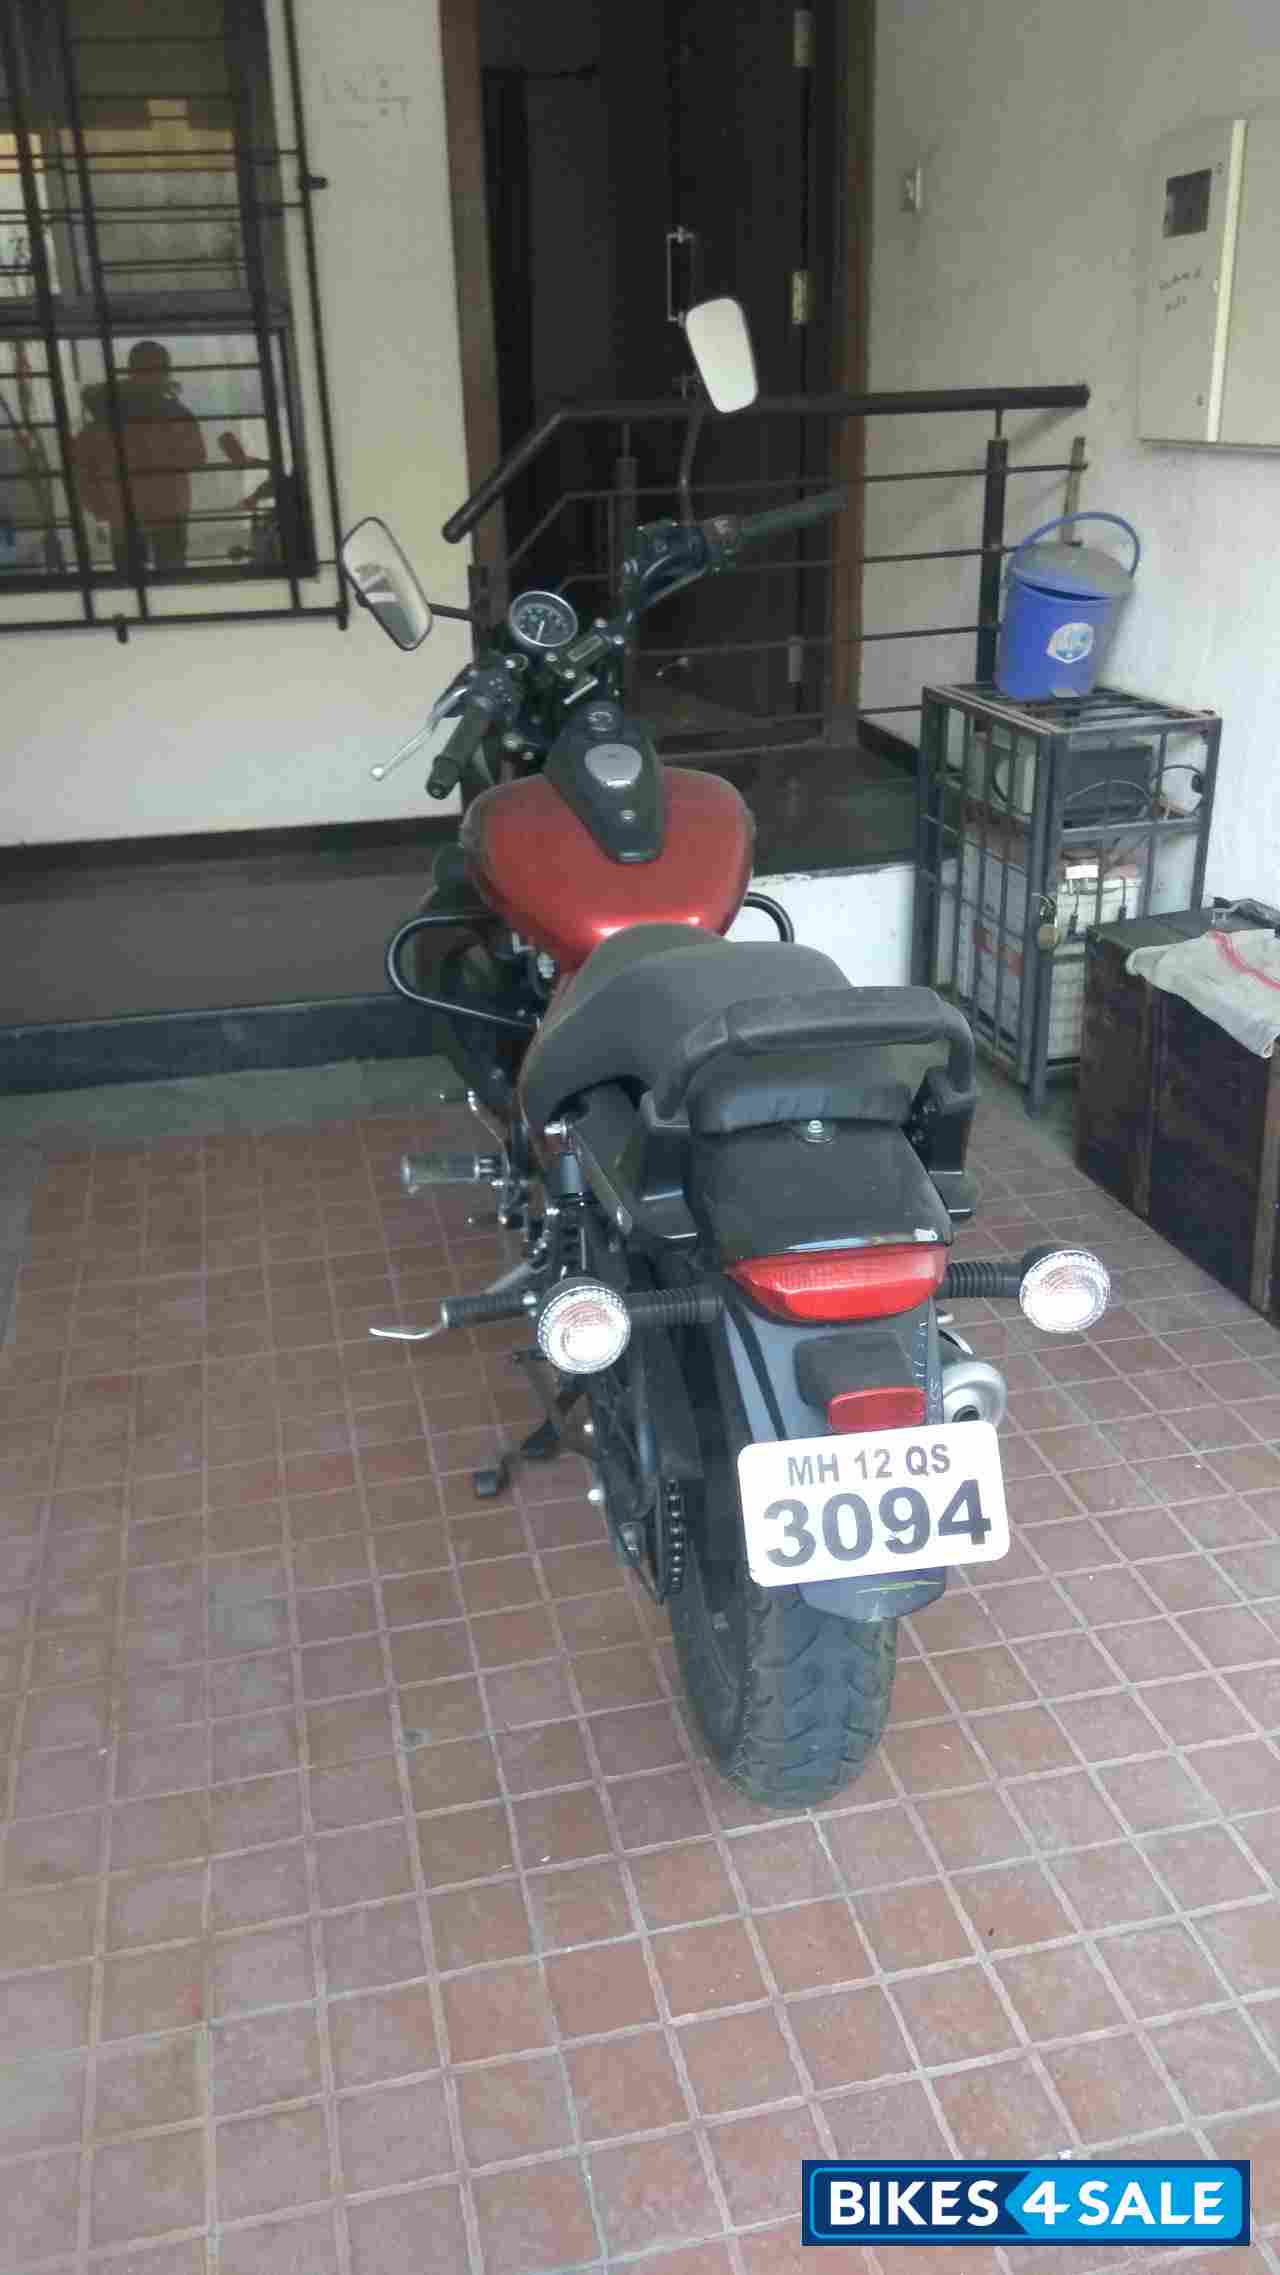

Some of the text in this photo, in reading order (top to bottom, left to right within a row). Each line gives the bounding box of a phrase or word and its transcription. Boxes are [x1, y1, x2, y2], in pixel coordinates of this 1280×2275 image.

[787, 1444, 951, 1487] MH 12 QS
[763, 1479, 992, 1568] 3094
